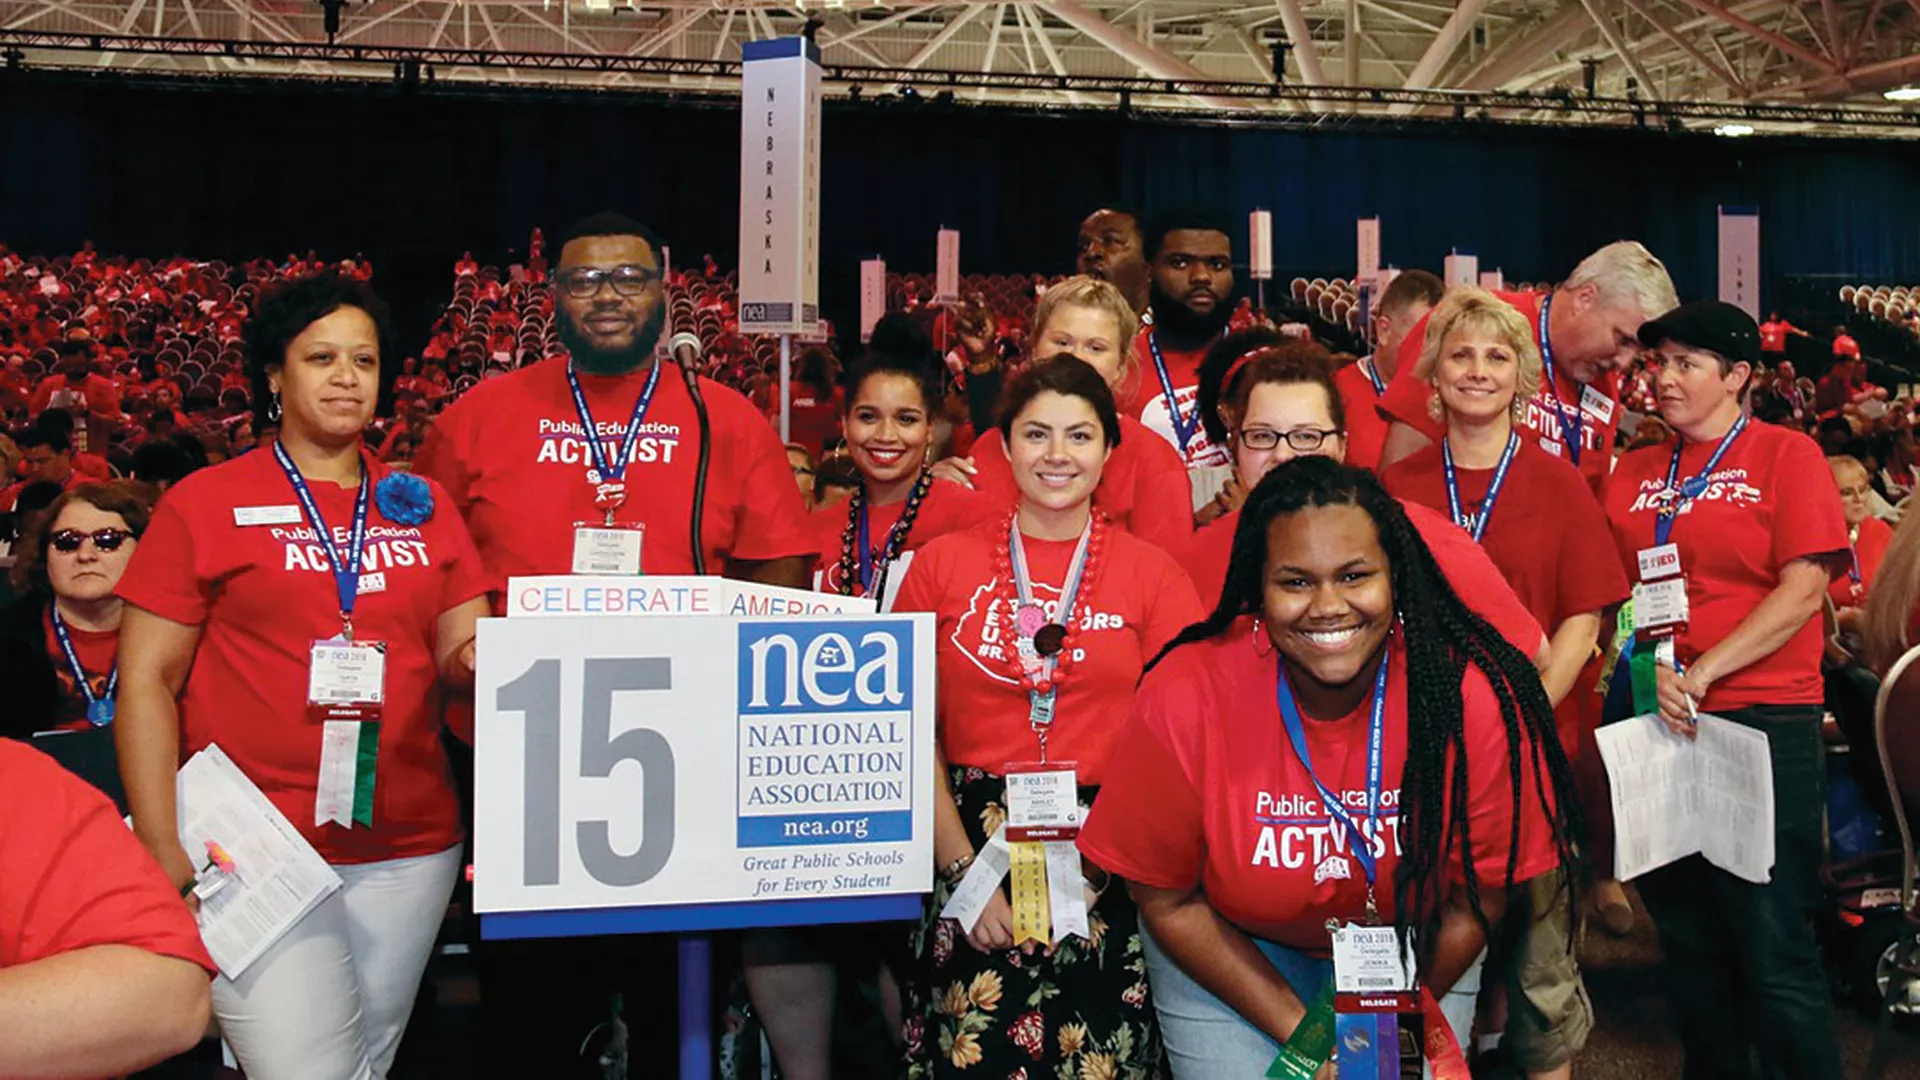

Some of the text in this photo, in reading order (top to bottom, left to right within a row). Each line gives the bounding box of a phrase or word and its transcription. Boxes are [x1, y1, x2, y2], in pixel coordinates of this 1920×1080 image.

[764, 87, 775, 274] NEBRASKA
[595, 421, 680, 436] Eduation
[537, 437, 679, 467] ACTVIST
[271, 526, 421, 543] Publi Ecation
[285, 540, 430, 572] ACVIST
[519, 588, 709, 612] CELEBRATE
[748, 631, 904, 707] nea
[748, 722, 904, 747] NATIONAL
[496, 657, 675, 887] 15
[748, 752, 903, 777] EDUCATION
[747, 781, 903, 805] ASSOCIATION
[1257, 791, 1317, 815] Public
[784, 817, 869, 838] nea.org
[743, 850, 904, 872] Great Public Schools
[752, 873, 891, 897] for Every Student
[1360, 999, 1397, 1007] DELEGATE
